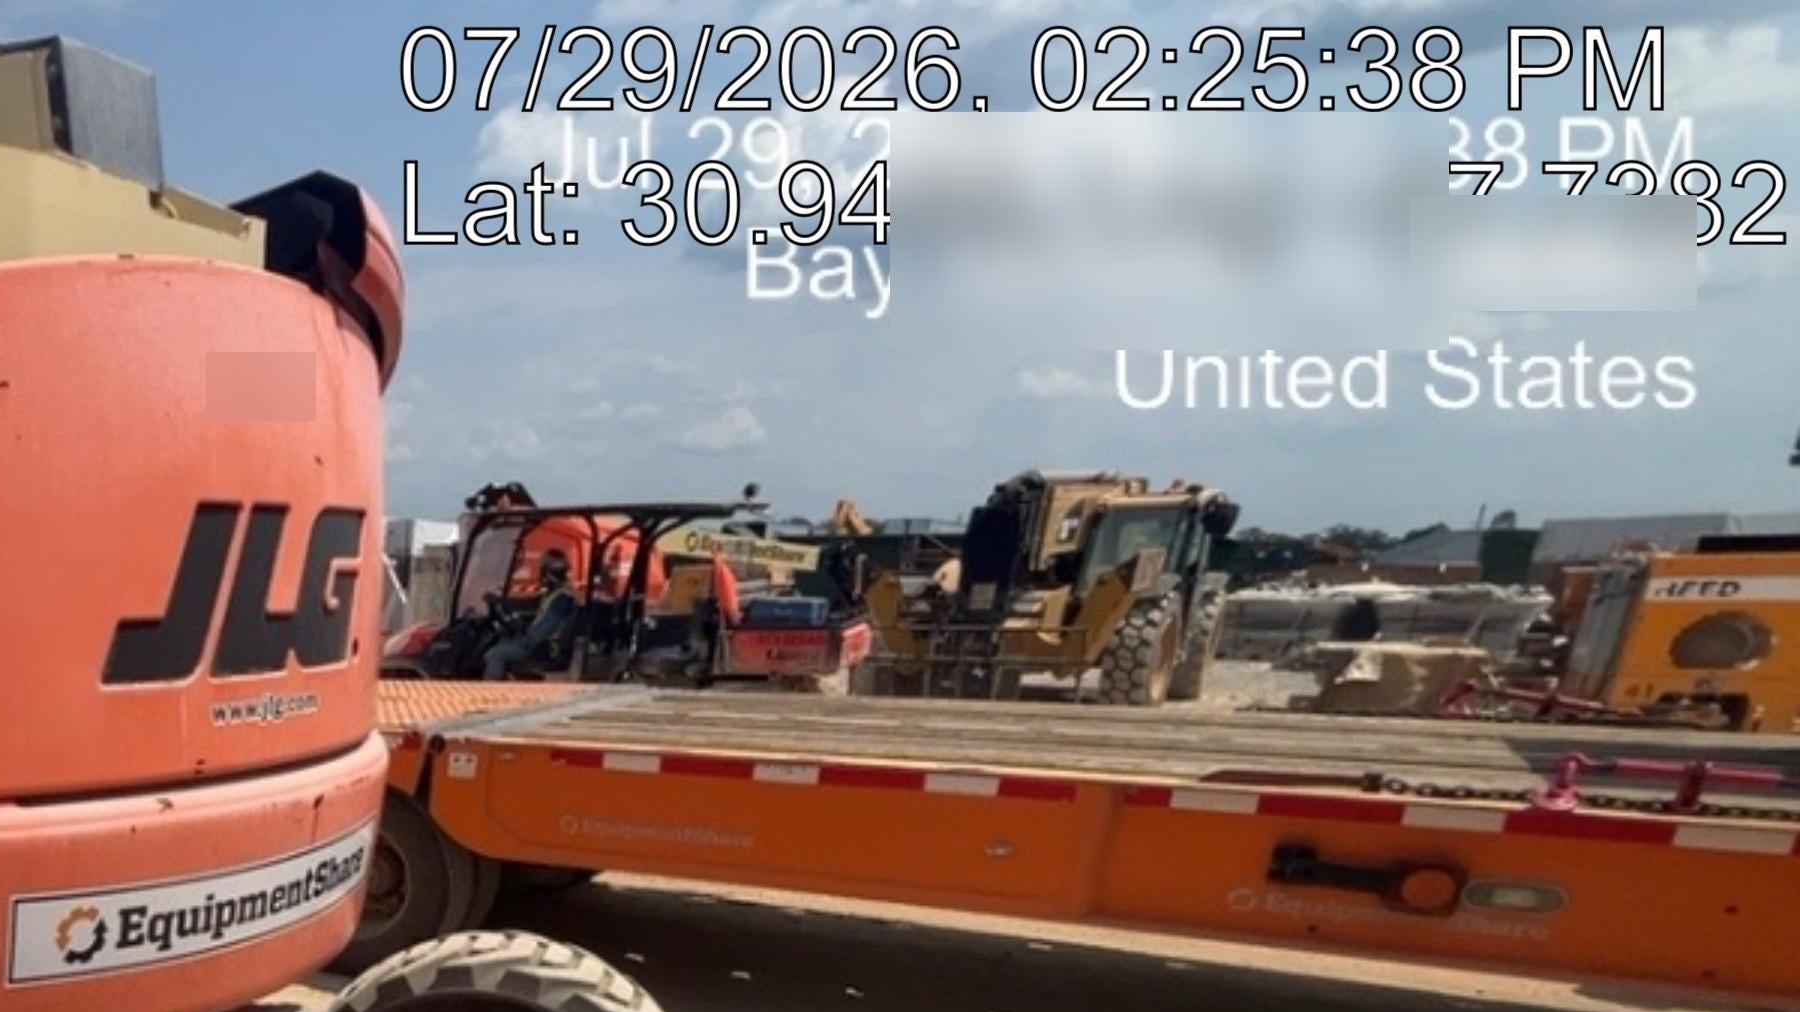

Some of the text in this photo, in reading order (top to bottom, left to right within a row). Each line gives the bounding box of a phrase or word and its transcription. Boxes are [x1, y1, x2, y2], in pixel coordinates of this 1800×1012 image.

[100, 500, 367, 686] JLG
[212, 695, 319, 726] www.jlg.com
[116, 845, 365, 951] EquipmentShare
